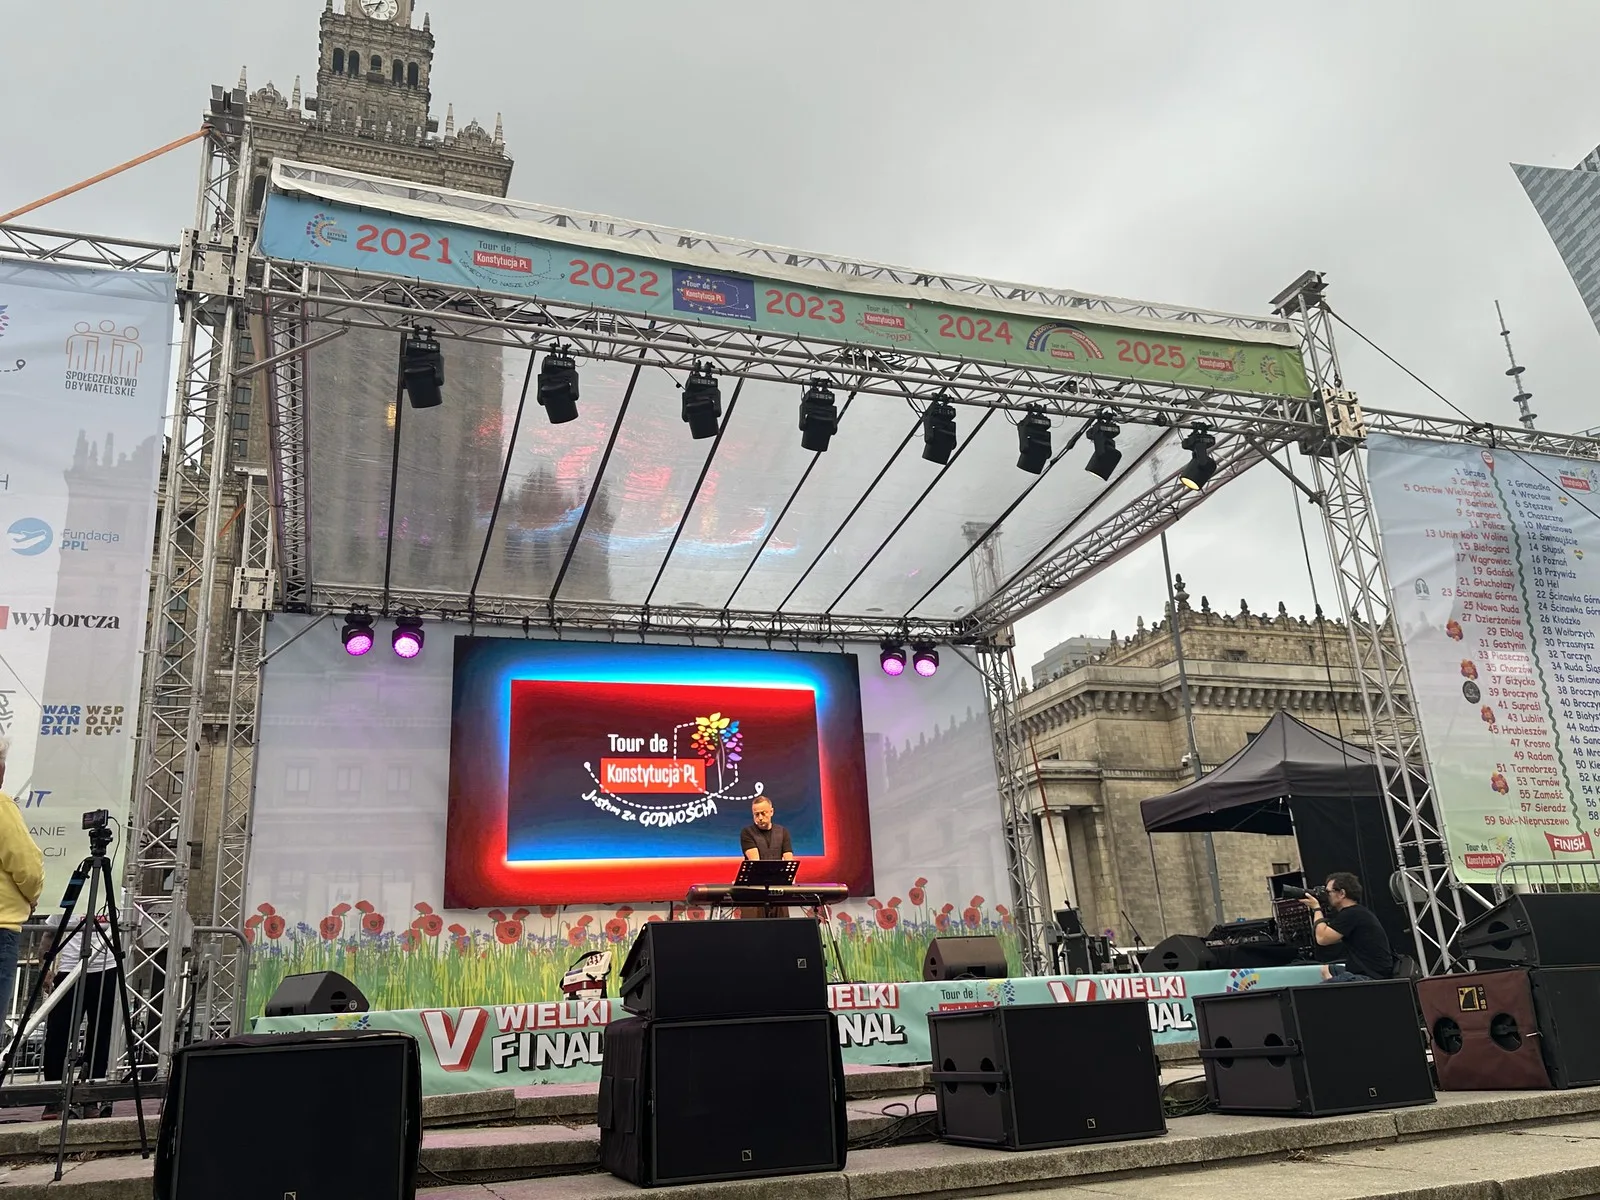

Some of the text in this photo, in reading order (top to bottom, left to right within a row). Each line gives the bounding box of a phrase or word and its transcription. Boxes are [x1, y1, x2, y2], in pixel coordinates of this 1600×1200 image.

[357, 224, 452, 264] 2021
[478, 240, 511, 253] Tour de
[477, 253, 528, 269] Konstytucja PL
[569, 259, 659, 296] 2022
[765, 289, 845, 324] 2023
[938, 314, 1013, 346] 2024
[1116, 339, 1186, 369] 2025
[66, 370, 137, 388] SPOŁECZEŃSTWO
[65, 380, 136, 397] OBYWATELSKIE
[1483, 521, 1505, 530] Police
[1536, 522, 1572, 533] Marianowo
[62, 529, 120, 544] Fundacja
[1425, 529, 1436, 537] 13
[1439, 530, 1458, 539] Unin
[1527, 531, 1578, 546] 12 Świnoujście
[61, 541, 88, 550] PPL
[1473, 543, 1509, 554] Białogard
[1542, 544, 1565, 555] Słupsk
[1532, 555, 1567, 566] 16 Poznań
[1473, 566, 1514, 577] 19 Gdańsk
[1533, 567, 1576, 579] 18 Przywidz
[1460, 577, 1515, 592] 21 Głuchołazy
[1456, 586, 1492, 600] Ścinawka
[1495, 592, 1518, 601] Górna
[1549, 589, 1581, 602] Ścinawka
[1464, 601, 1520, 613] 25 Nowa Ruda
[1551, 601, 1583, 614] Ścinawka
[12, 607, 120, 631] wyborcza
[1462, 613, 1521, 625] 27 Dzierżoniów
[1540, 614, 1580, 625] 26 Kłodzko
[1487, 627, 1523, 640] 29 Elbląg
[1542, 626, 1595, 639] 28 Wałbrzych
[1480, 639, 1526, 651] 31 Gostynin
[1545, 638, 1594, 650] 30 Przasnysz
[1478, 651, 1529, 661] 33 Piaseczno
[1548, 650, 1592, 662] 32 Tarczyn
[1564, 662, 1583, 671] Ruda
[1505, 676, 1535, 687] Giżycko
[1554, 674, 1564, 682] 36
[1489, 688, 1499, 696] 39
[1502, 689, 1538, 700] Broczyno
[1557, 686, 1567, 694] 38
[1498, 701, 1541, 712] 41 Supraśl
[1560, 698, 1570, 707] 40
[42, 705, 124, 715] WAR WSP
[1564, 711, 1573, 719] 42
[42, 714, 123, 726] DYŃ ÓLN
[1508, 713, 1544, 722] 43 Lublin
[1488, 725, 1547, 736] 45 Hrubieszów
[1566, 722, 1576, 731] 44
[607, 733, 668, 752] Tour de
[1524, 740, 1550, 749] Krosno
[1570, 735, 1580, 744] 46
[1514, 751, 1554, 761] 49 Radom
[1573, 748, 1583, 756] 48
[1496, 764, 1557, 776] 51 Tarnobrzeg
[1576, 760, 1586, 769] 50
[607, 764, 698, 788] Konstytucja PL
[1516, 777, 1560, 786] 53 Tarnów
[1519, 790, 1564, 799] 55 Zamość
[1521, 803, 1566, 812] 57 Sieradz
[1484, 816, 1569, 827] 59 Buk-Niepruszewo
[29, 826, 66, 836] ANIE
[1465, 843, 1480, 852] Tour
[1554, 837, 1586, 851] FINISH
[43, 847, 66, 856] CJI
[940, 988, 973, 1000] Tour de
[1100, 976, 1187, 1000] WIELKI
[828, 984, 900, 1010] IELKI
[494, 1000, 611, 1032] WIELKI
[837, 1013, 908, 1048] NAŁ
[420, 1007, 490, 1073] V
